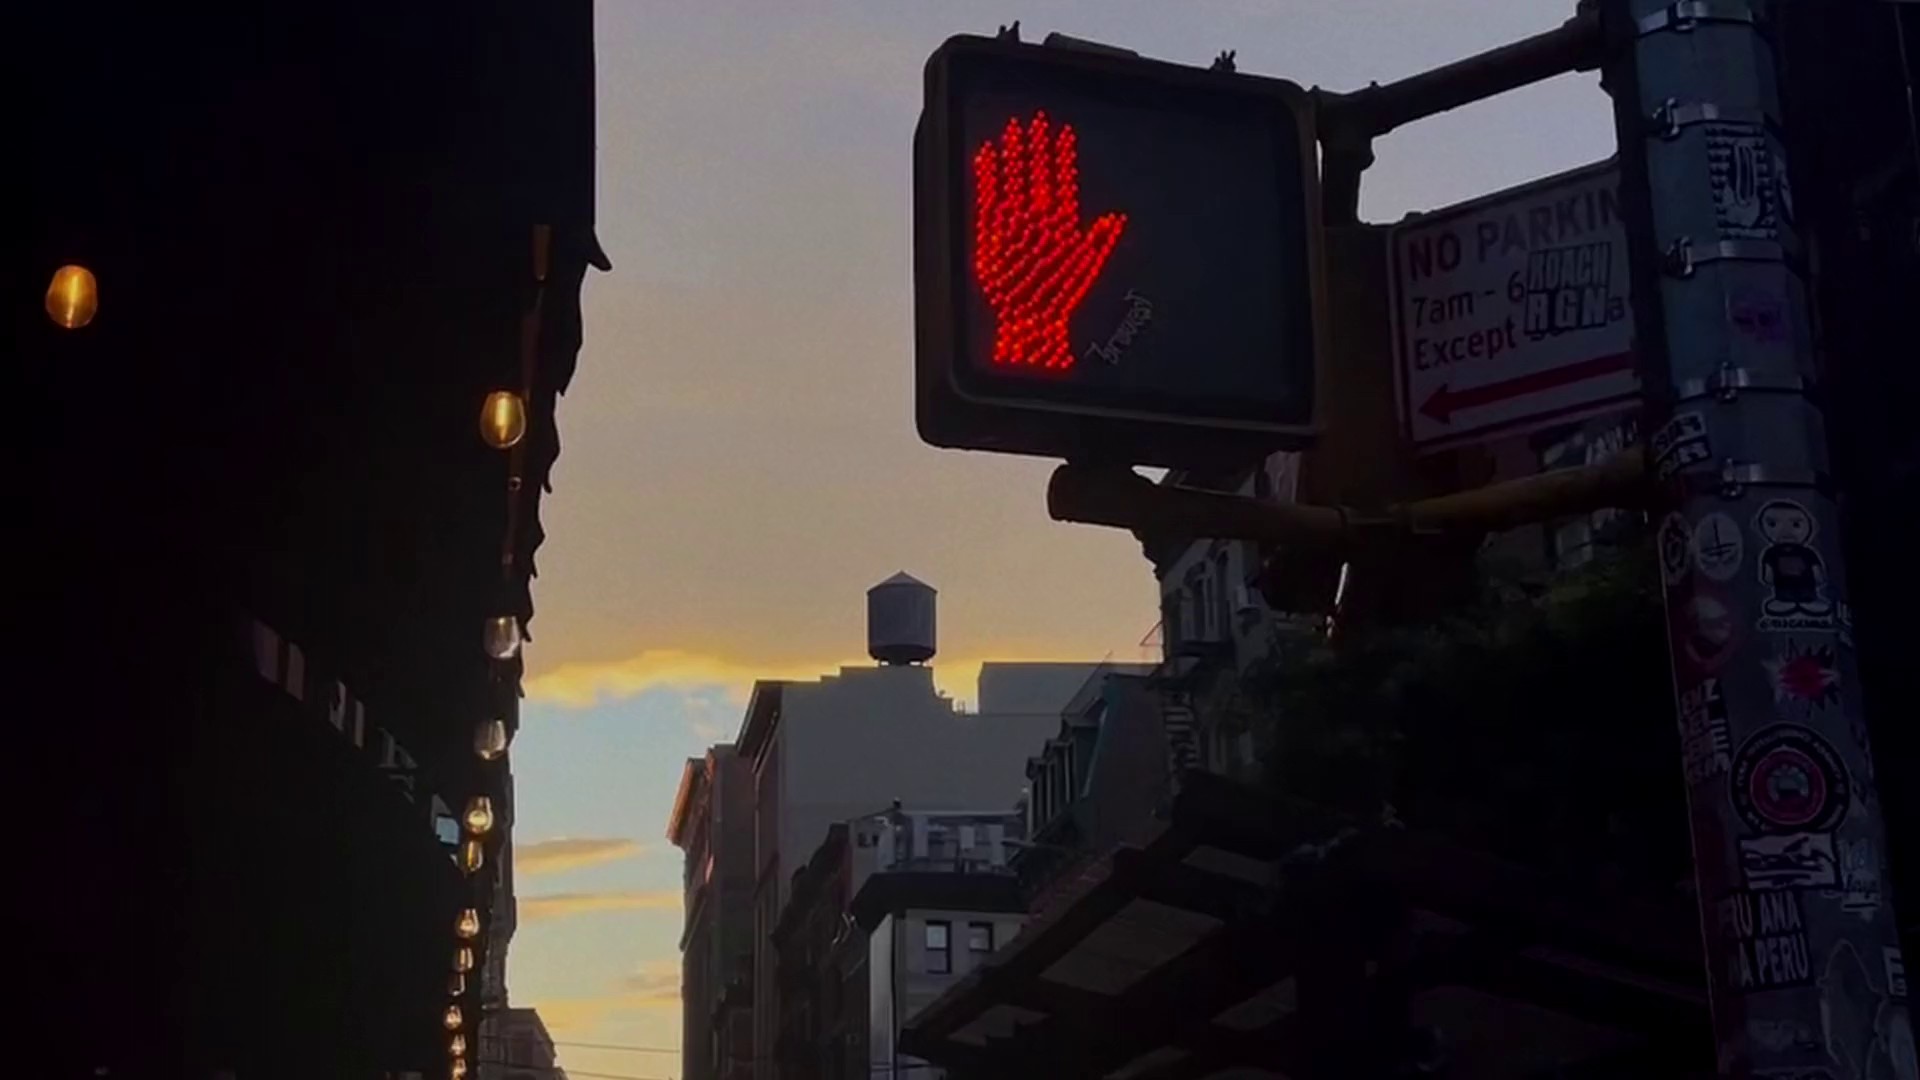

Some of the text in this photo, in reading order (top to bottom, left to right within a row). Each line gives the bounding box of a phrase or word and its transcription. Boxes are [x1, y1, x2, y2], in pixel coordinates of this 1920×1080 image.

[1409, 186, 1621, 281] NO PARKIN
[1412, 290, 1474, 328] 7am
[1414, 317, 1518, 371] Except
[1754, 931, 1809, 985] PERU
